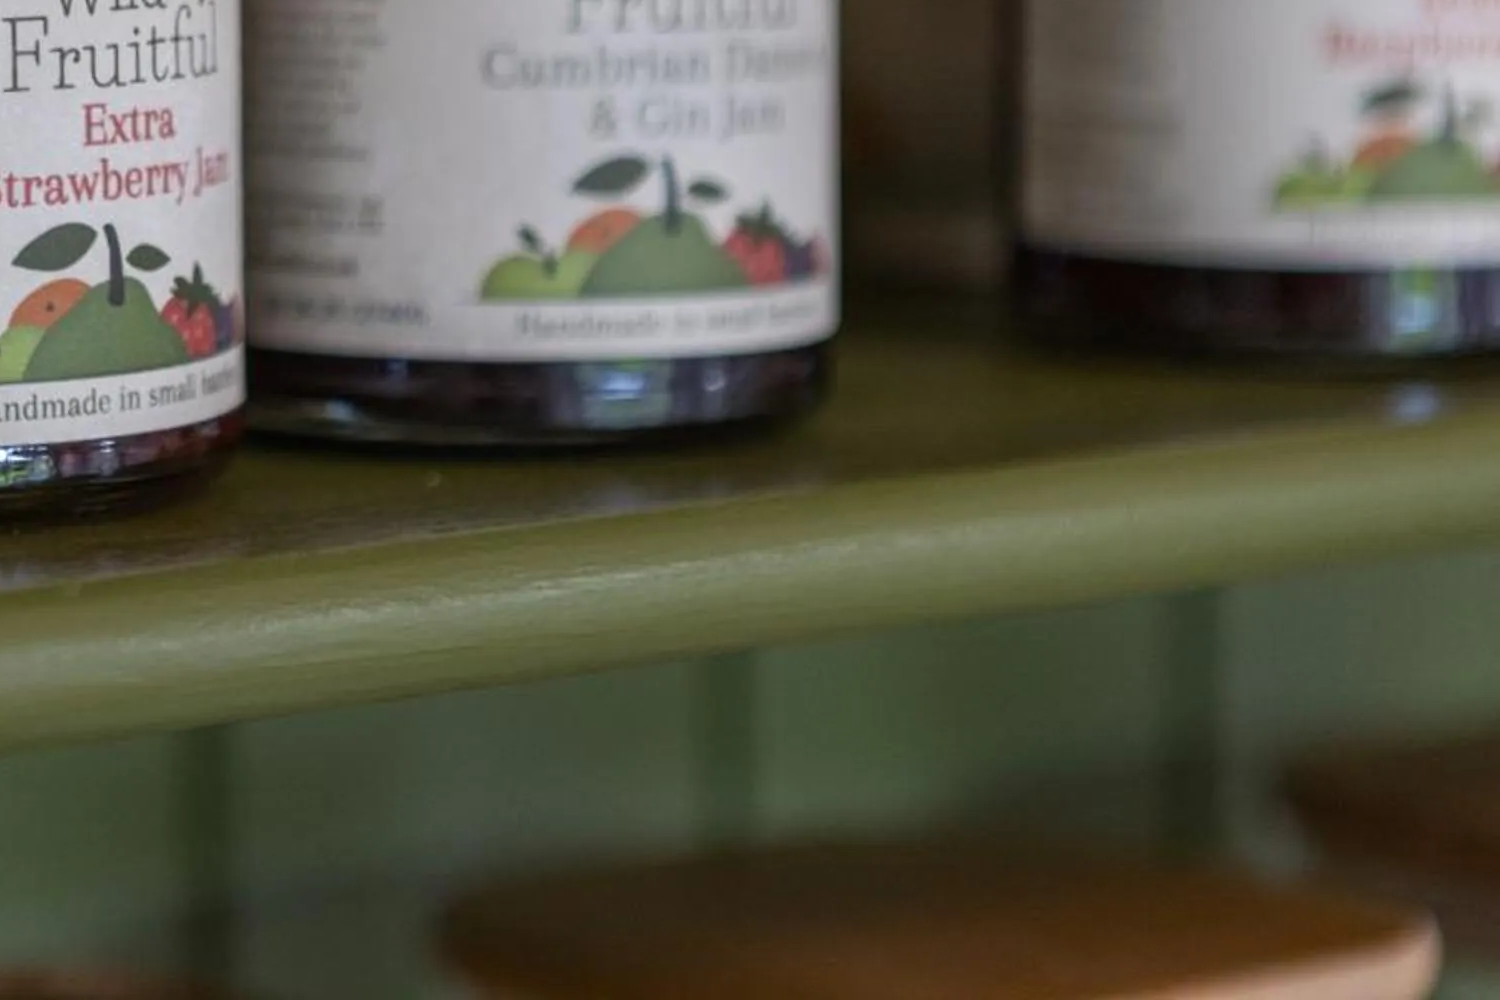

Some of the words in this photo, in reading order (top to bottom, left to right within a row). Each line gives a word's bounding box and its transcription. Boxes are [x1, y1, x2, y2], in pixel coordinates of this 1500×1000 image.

[3, 0, 219, 93] Fruitful
[82, 102, 176, 148] Extra
[118, 384, 141, 413] in
[148, 372, 198, 408] small
